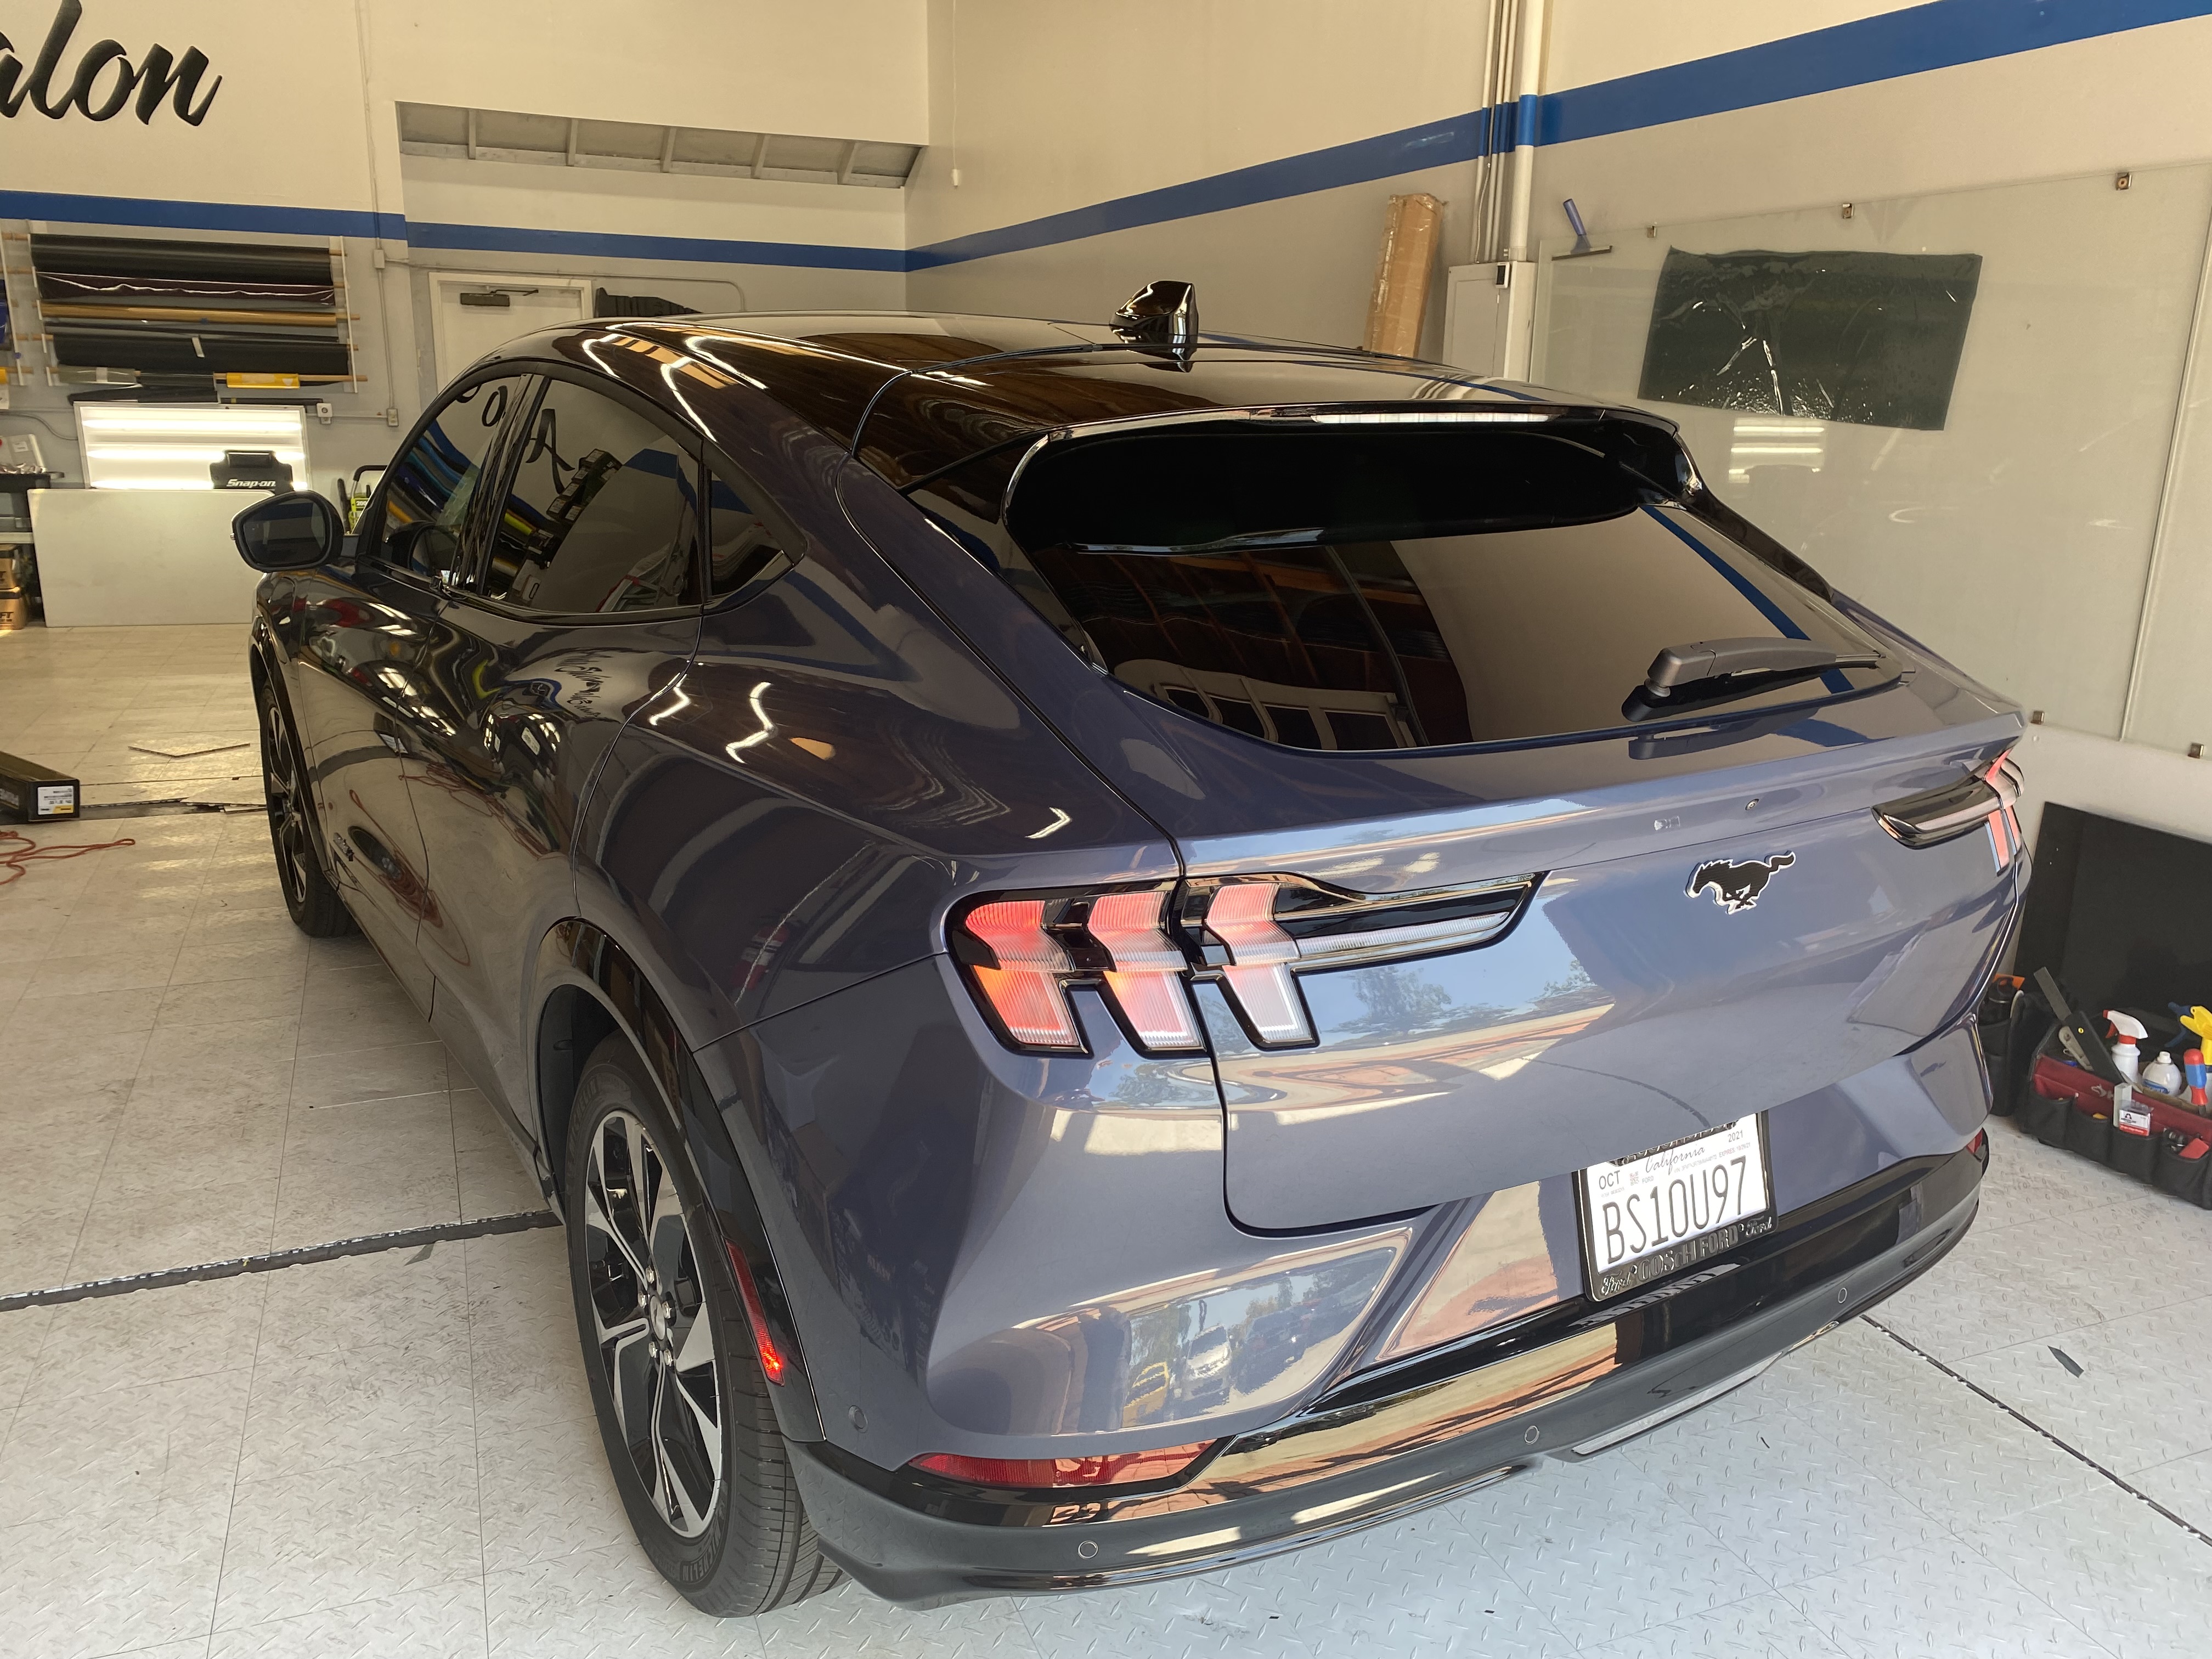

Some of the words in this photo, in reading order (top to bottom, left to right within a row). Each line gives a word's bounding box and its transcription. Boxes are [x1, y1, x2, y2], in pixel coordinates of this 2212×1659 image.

[226, 478, 276, 488] Snap-on
[1728, 1129, 1744, 1143] 2021
[1645, 1143, 1706, 1176] California
[1599, 1170, 1621, 1190] OCT
[1642, 1175, 1654, 1184] FORD
[1602, 1155, 1746, 1265] BS10U97
[1699, 1224, 1739, 1257] FORD
